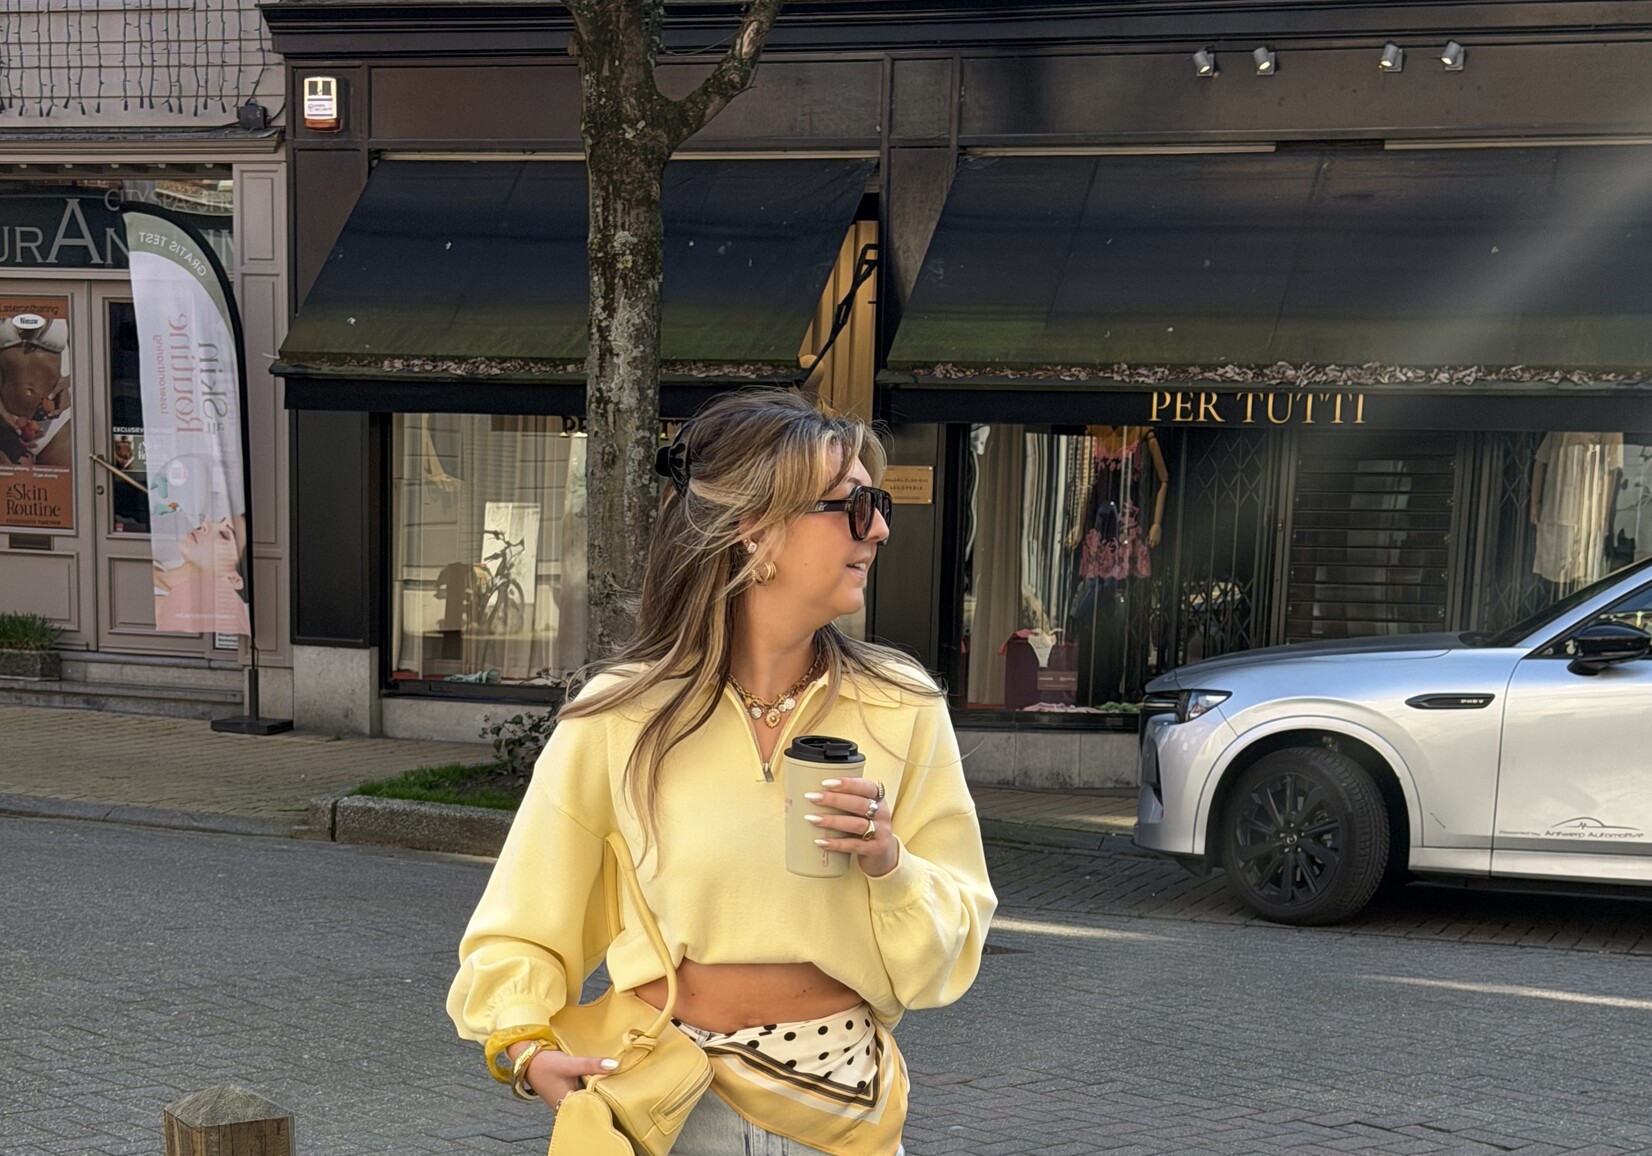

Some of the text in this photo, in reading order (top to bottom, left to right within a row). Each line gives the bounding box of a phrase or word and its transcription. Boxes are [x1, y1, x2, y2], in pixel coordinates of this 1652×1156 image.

[1148, 391, 1366, 424] PER TUTTI
[13, 483, 48, 501] Skin
[7, 499, 61, 517] Routine
[1544, 830, 1585, 838] Antwerp
